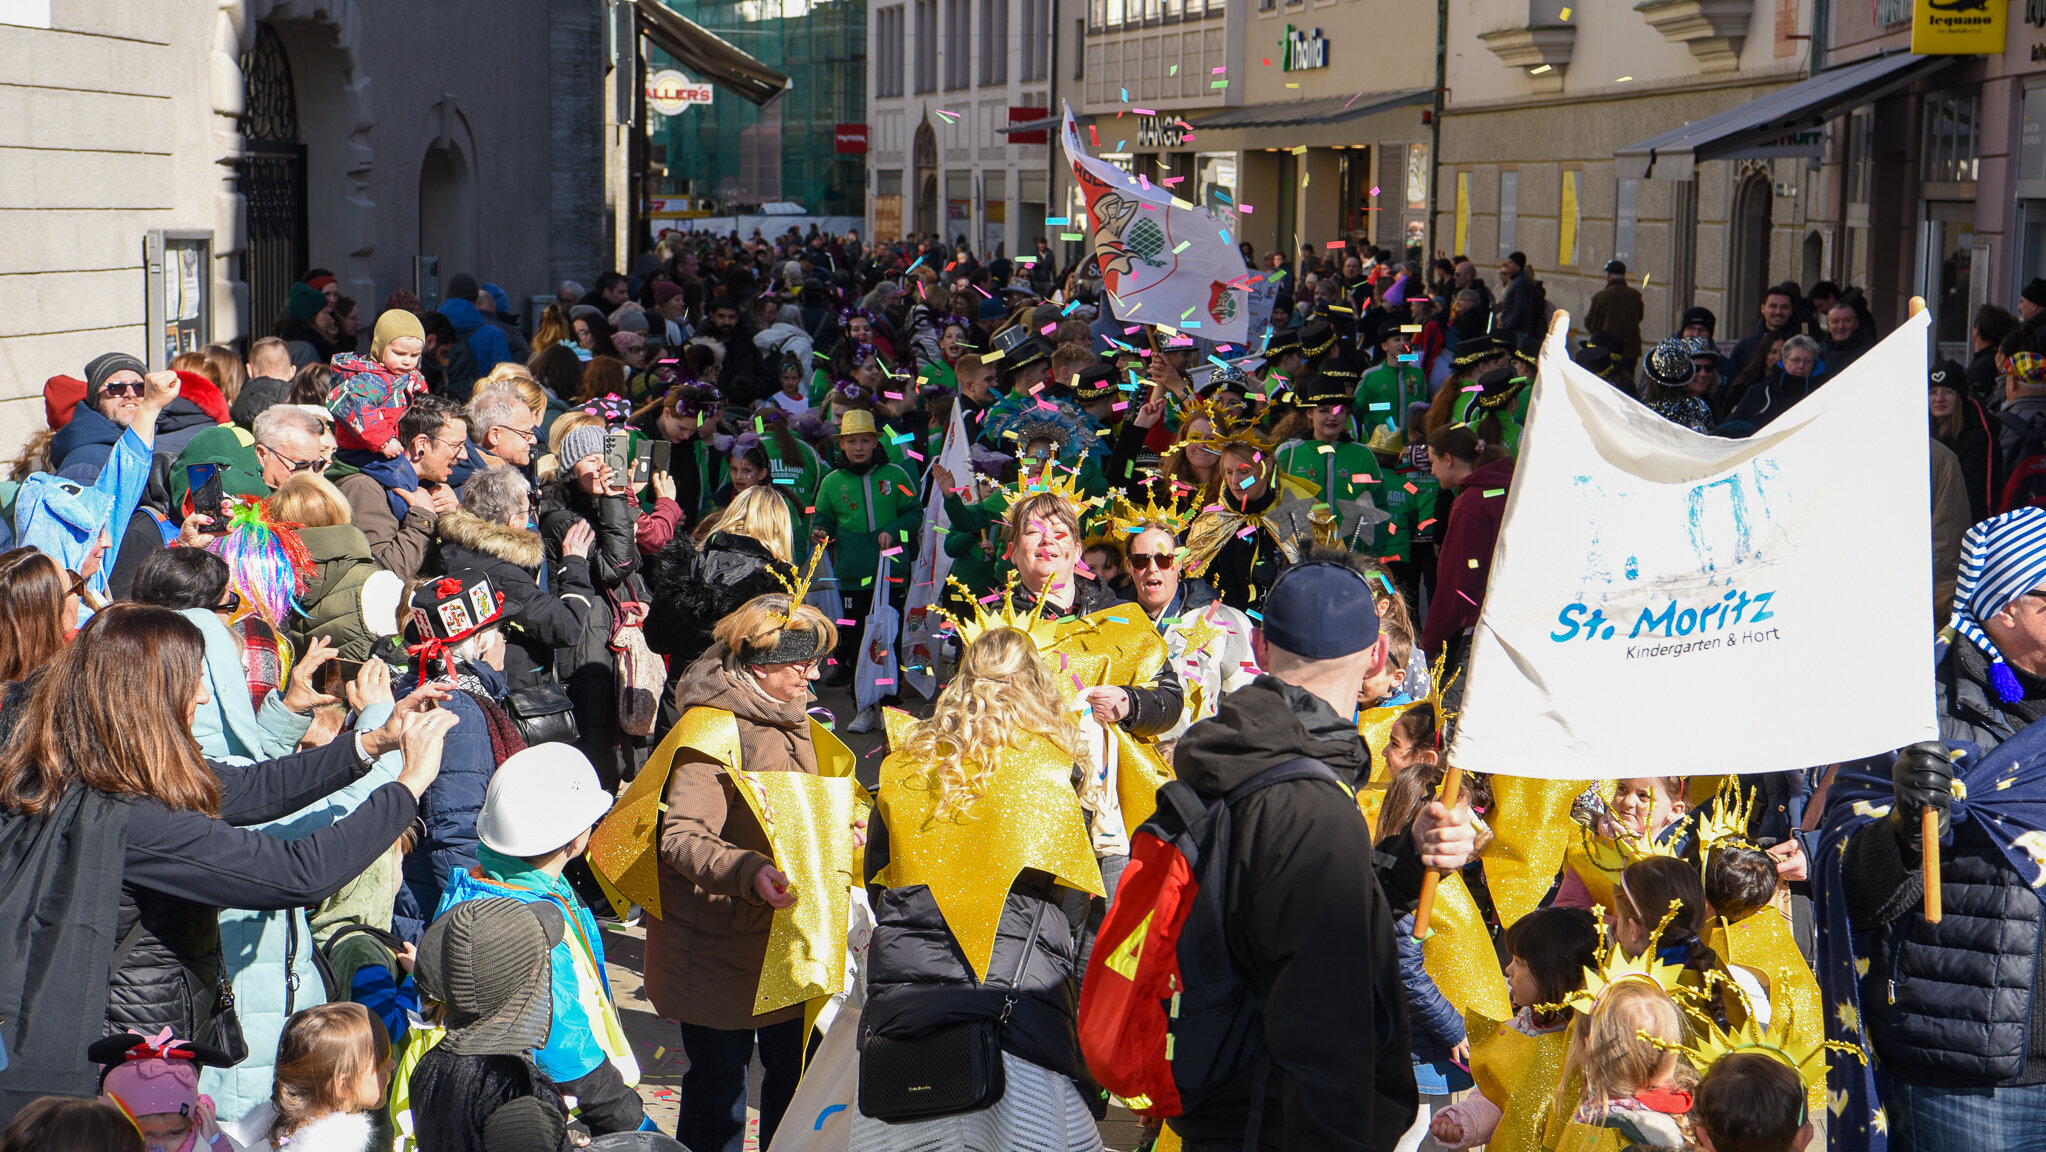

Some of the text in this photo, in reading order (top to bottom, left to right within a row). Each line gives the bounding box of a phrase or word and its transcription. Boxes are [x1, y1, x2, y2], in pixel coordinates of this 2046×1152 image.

[1137, 116, 1184, 147] MANGO
[1550, 589, 1777, 644] St. Moritz
[1626, 627, 1781, 660] Kindergarten & Hort
